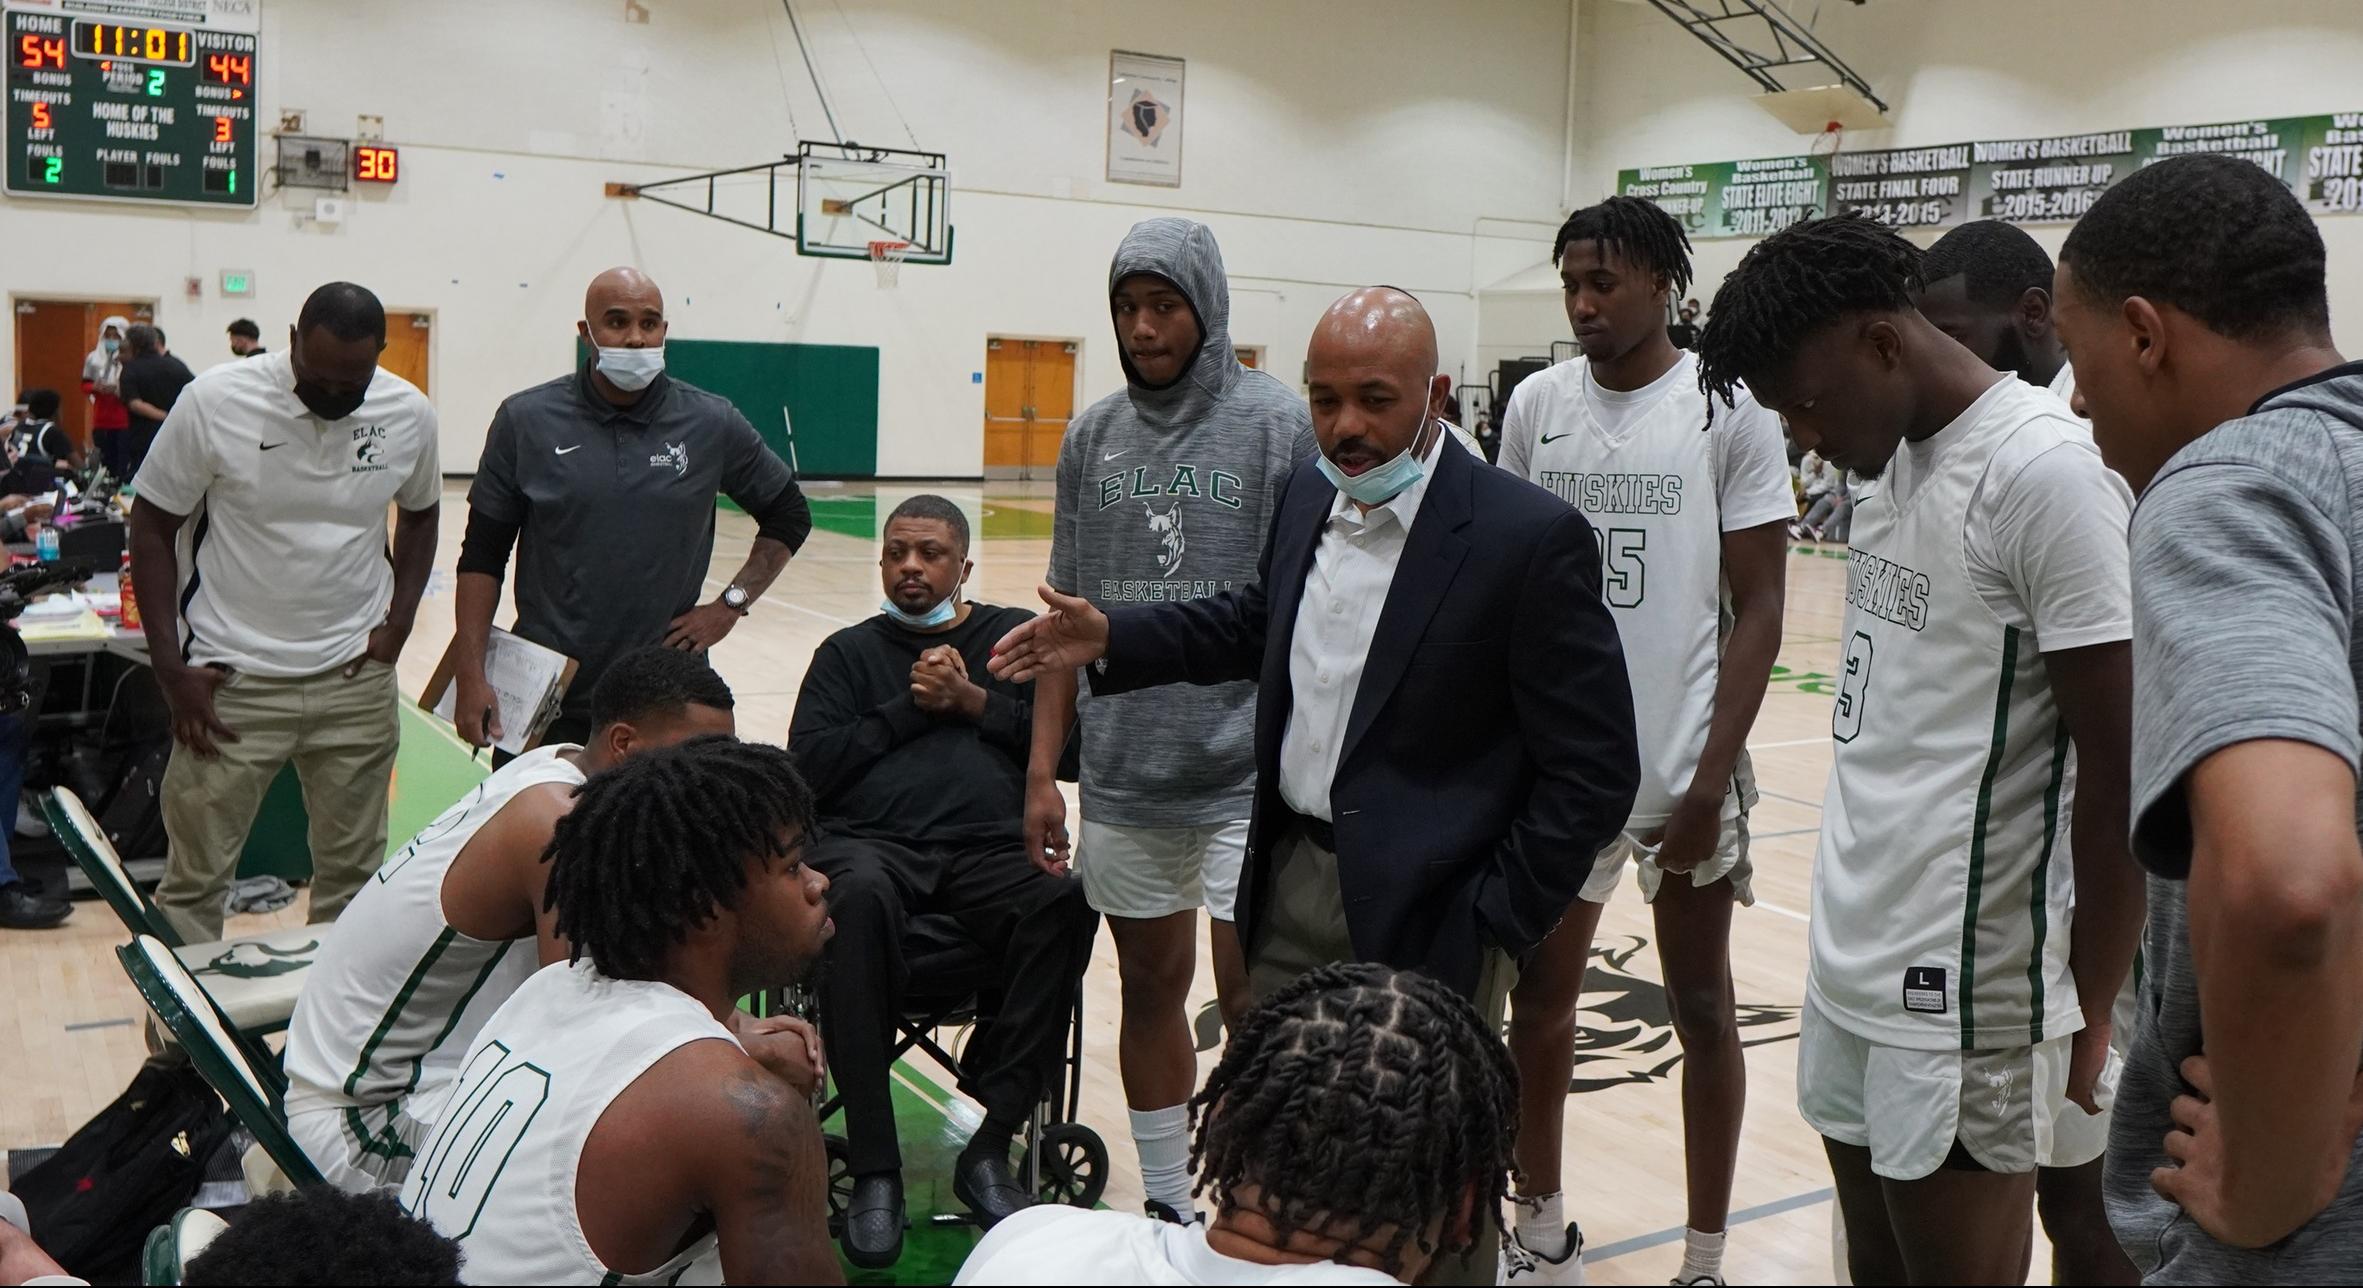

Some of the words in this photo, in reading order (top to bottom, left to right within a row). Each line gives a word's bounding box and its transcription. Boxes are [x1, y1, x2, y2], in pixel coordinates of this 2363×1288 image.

[16, 15, 62, 33] HOME
[93, 23, 186, 62] 11:01
[197, 32, 254, 51] VISITOR
[22, 35, 65, 69] 54
[33, 71, 72, 86] BONUS
[102, 71, 143, 86] PERIOD
[210, 54, 250, 85] 44
[147, 69, 165, 96] 2
[195, 86, 231, 99] BONUS
[13, 89, 72, 105] TIMEOUTS
[32, 102, 50, 128] 5
[92, 102, 129, 121] HOME
[131, 105, 149, 122] OF
[151, 107, 175, 125] THE
[196, 104, 250, 120] TIMEOUTS
[28, 128, 55, 141] LEFT
[106, 121, 158, 141] HUSKIES
[215, 117, 232, 142] 3
[2162, 122, 2268, 141] Women's
[27, 145, 63, 157] FOULS
[209, 141, 236, 153] LEFT
[1973, 141, 2039, 162] WOMEN'S
[2040, 132, 2132, 159] BASKETBALL
[2156, 134, 2279, 155] Basketball
[96, 149, 138, 163] PLAYER
[145, 152, 180, 166] FOULS
[203, 156, 237, 169] FOULS
[359, 149, 395, 179] 30
[1736, 157, 1809, 173] Women's
[1831, 153, 1889, 177] WOMEN'S
[1890, 146, 1969, 174] BASKETBALL
[2308, 145, 2363, 178] STATE
[45, 157, 63, 183] 2
[1639, 164, 1693, 182] Women's
[1731, 167, 1815, 184] Basketball
[1991, 169, 2032, 190] STATE
[2033, 165, 2089, 187] RUNNER
[2091, 164, 2112, 184] UP
[229, 170, 236, 195] 1
[1626, 183, 1660, 197] Cross
[1661, 180, 1709, 196] Country
[1836, 182, 1877, 200] STATE
[1879, 179, 1918, 198] FINAL
[1920, 176, 1960, 196] FOUR
[1721, 184, 1754, 209] STATE
[1754, 182, 1783, 207] ELITE
[1784, 180, 1820, 205] EIGHT
[2003, 191, 2094, 217] 2015-2016
[353, 425, 386, 441] ELAC
[650, 453, 672, 463] elac
[352, 464, 388, 473] BASKETBALL
[1099, 464, 1242, 511] ELAC
[1846, 547, 1930, 632] USKIES
[1832, 630, 1873, 744] 3
[1919, 971, 1930, 985] L
[409, 1039, 551, 1242] 10
